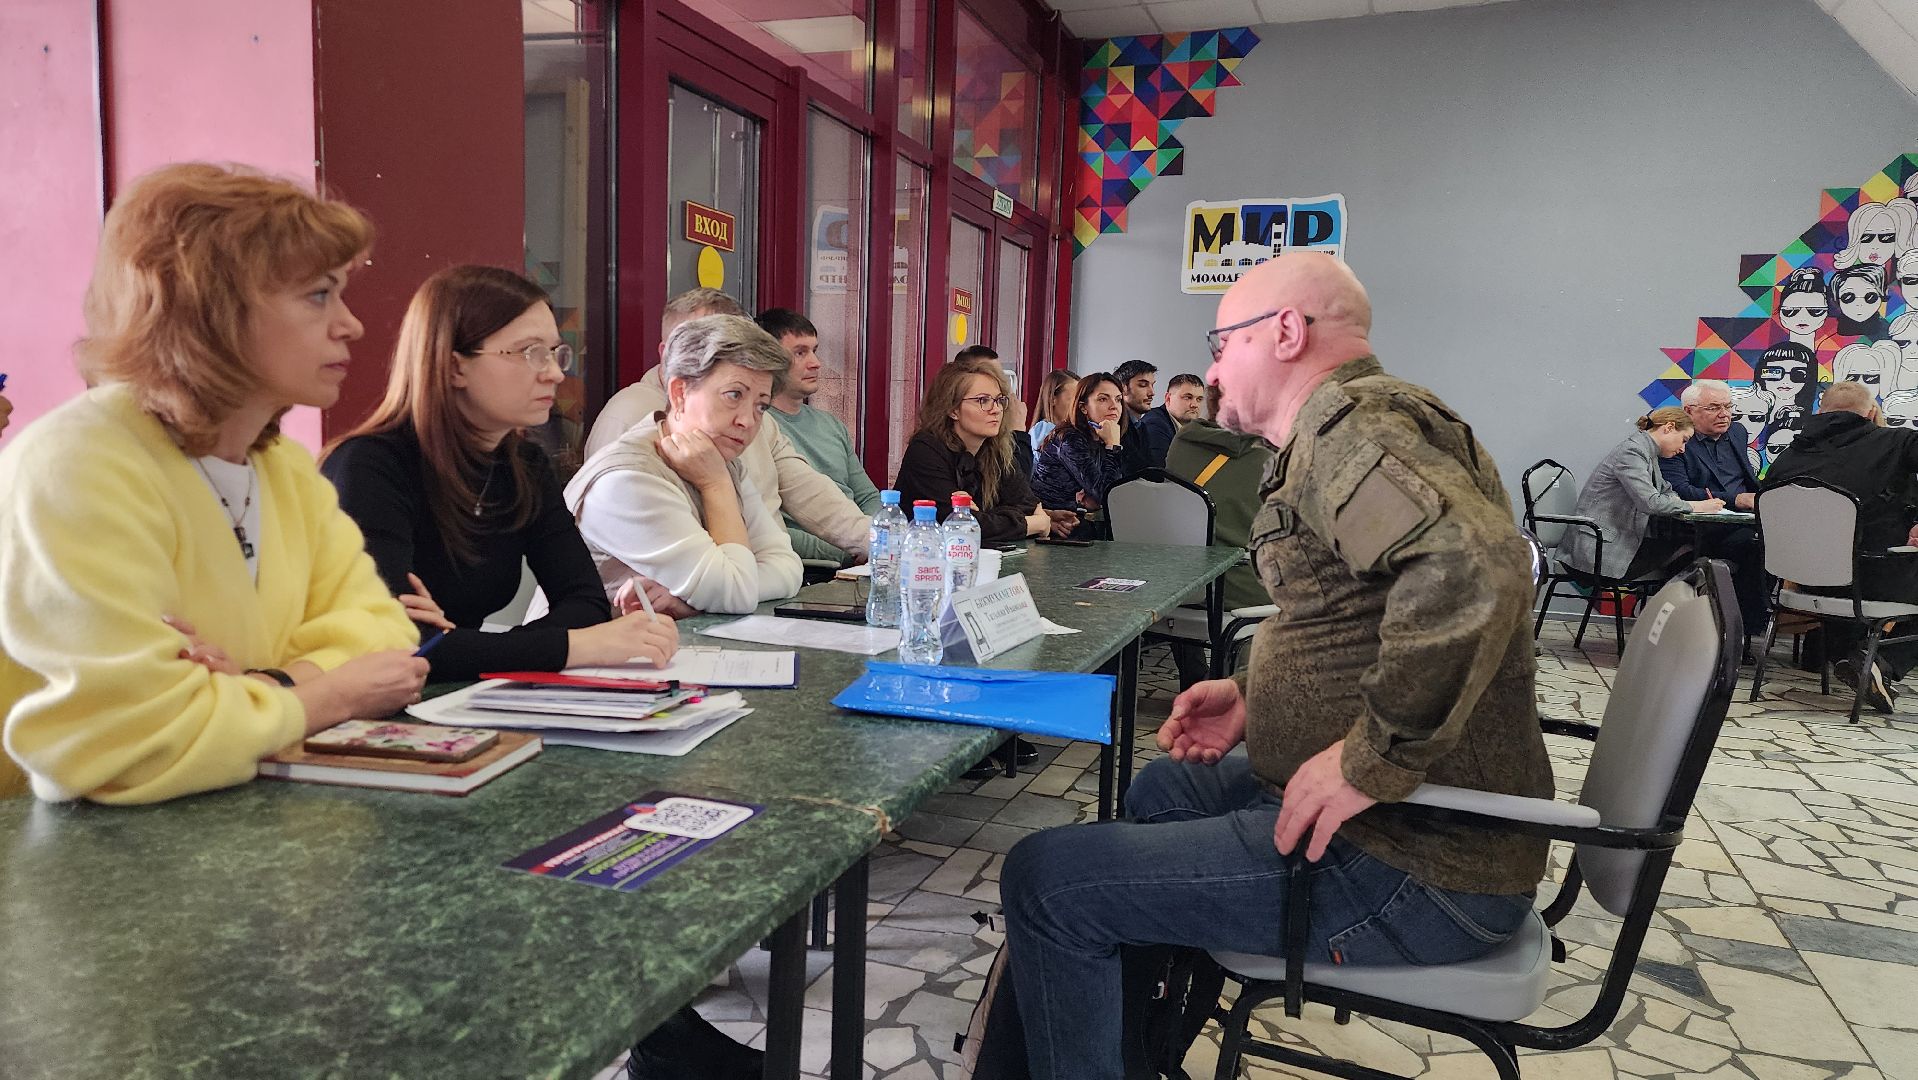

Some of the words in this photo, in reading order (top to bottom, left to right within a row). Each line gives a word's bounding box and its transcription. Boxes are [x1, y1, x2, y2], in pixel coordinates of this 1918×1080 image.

[694, 213, 727, 244] ВХОД
[1192, 210, 1334, 269] МИР
[1191, 272, 1243, 283] МОЛОДЕ
[948, 551, 973, 560] spring
